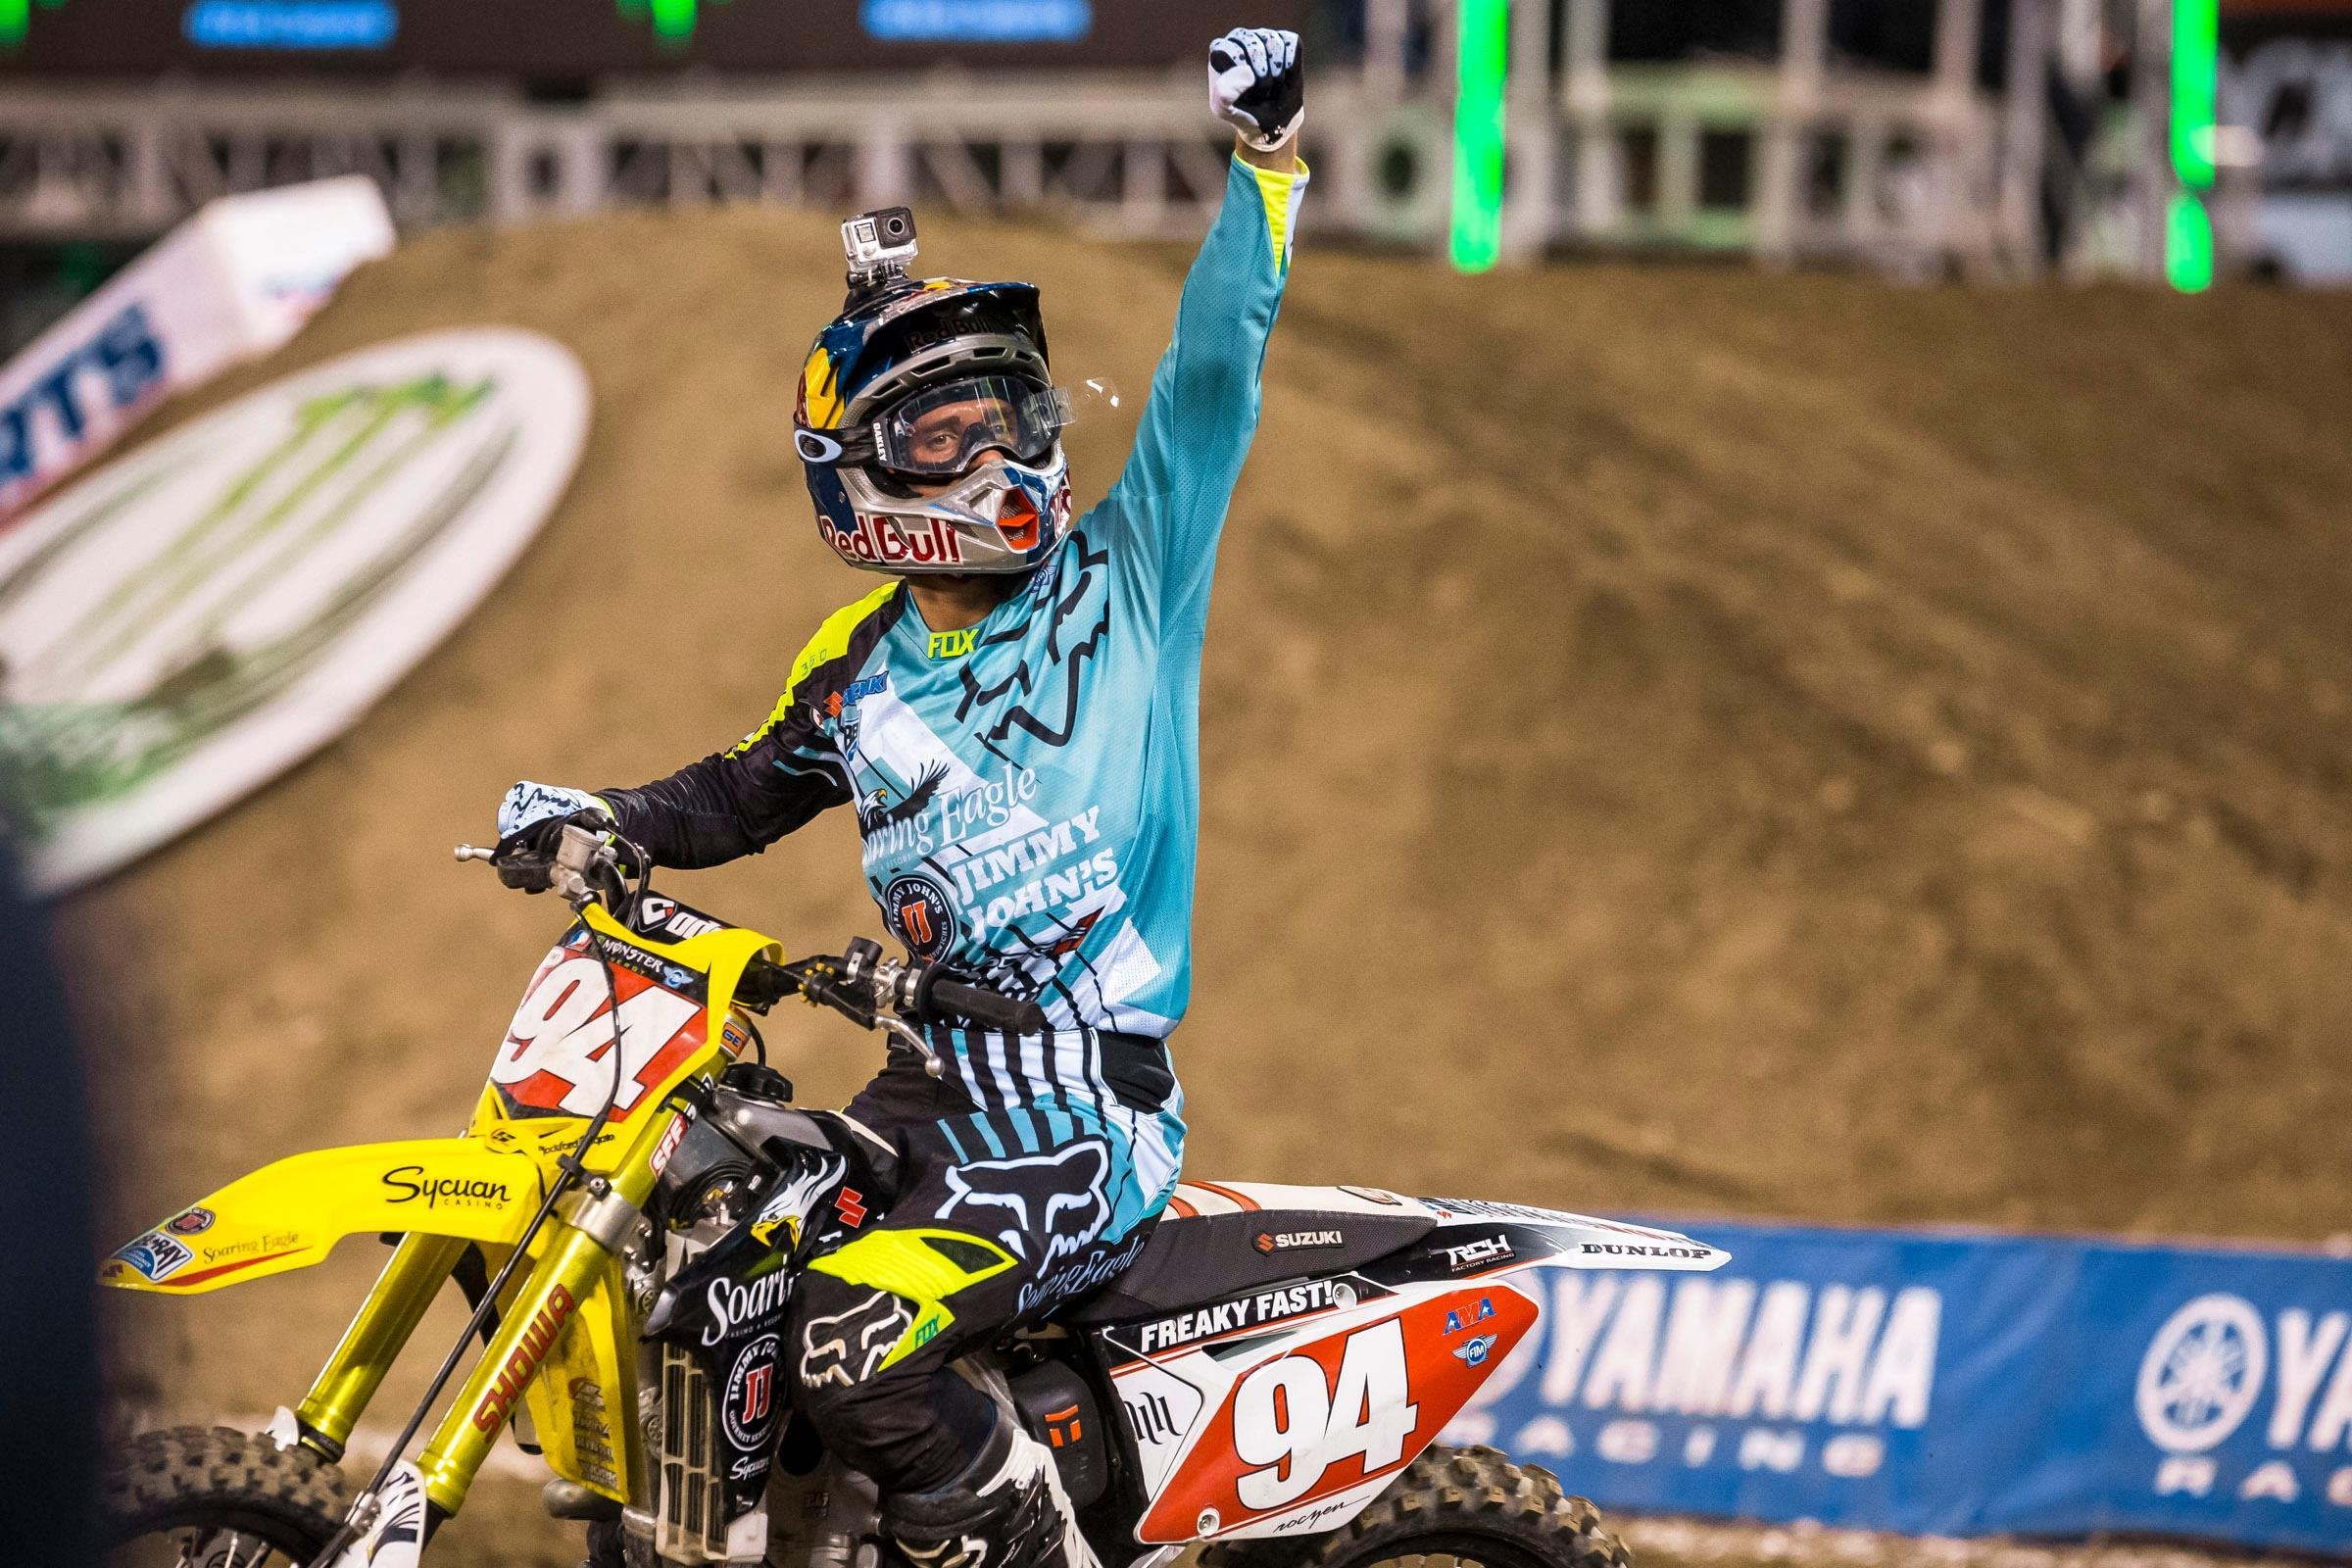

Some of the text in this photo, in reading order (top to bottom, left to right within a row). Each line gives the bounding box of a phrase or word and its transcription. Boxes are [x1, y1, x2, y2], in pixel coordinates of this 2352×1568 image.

[872, 422, 887, 462] OAKLEY
[927, 628, 979, 659] FOX
[938, 760, 1037, 847] Eagle
[951, 805, 1101, 907] JIMMY
[906, 883, 944, 914] JOHN'S
[967, 847, 1118, 948] JOHN'S
[602, 938, 664, 973] MONSTER
[491, 956, 704, 1119] 94
[382, 1165, 512, 1209] Sycuan
[443, 1199, 503, 1210] CASINO
[202, 1230, 299, 1266] Soaring Eagle
[1275, 1230, 1343, 1248] SUZUKI
[1446, 1234, 1512, 1266] RCH
[1581, 1243, 1712, 1260] DUNLOP
[1451, 1252, 1515, 1273] FACTORY RACING
[914, 1313, 941, 1348] FOX
[1140, 1280, 1334, 1353] FREAKY FAST!
[1443, 1298, 1497, 1337] AMA
[472, 1283, 574, 1444] SHOWA
[1469, 1344, 1486, 1360] FIM
[1537, 1274, 1944, 1431] YAMAHA
[1232, 1317, 1418, 1512] 94
